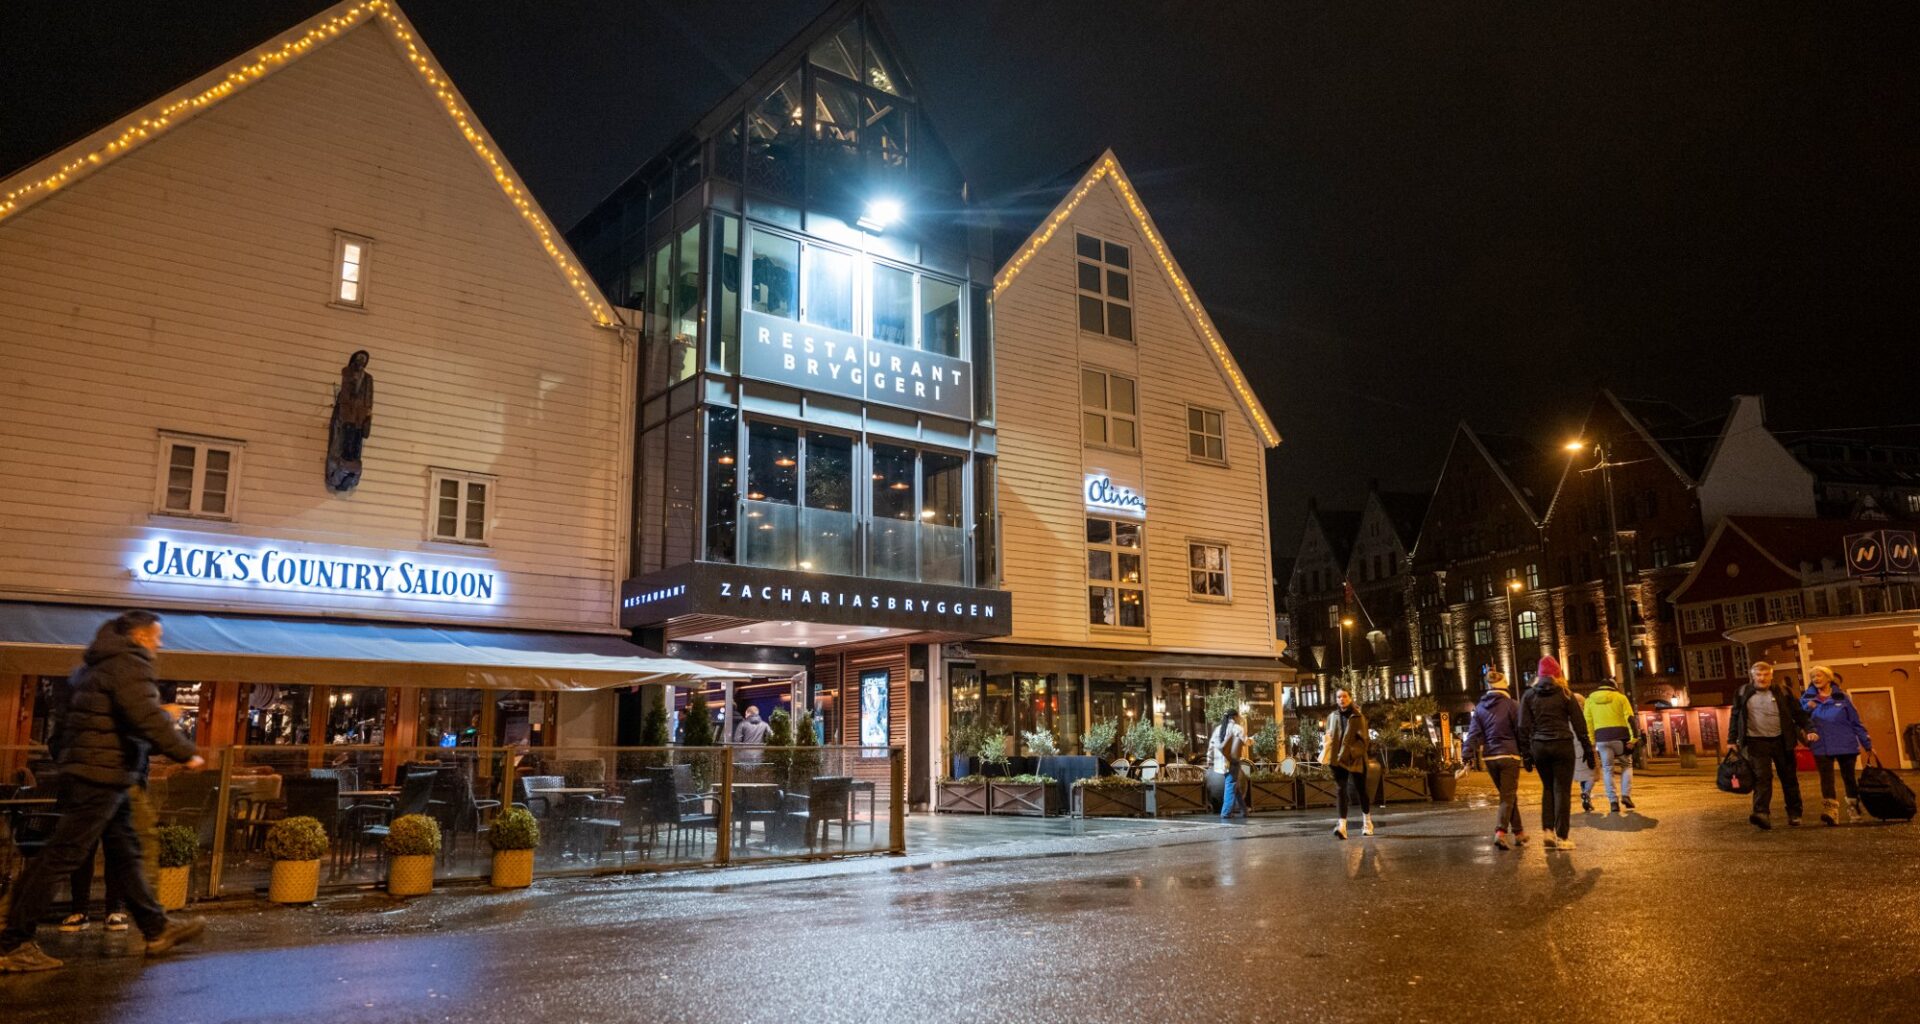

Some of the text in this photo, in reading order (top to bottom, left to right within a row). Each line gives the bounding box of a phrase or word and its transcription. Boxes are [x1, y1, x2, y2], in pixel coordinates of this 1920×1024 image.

[758, 326, 962, 386] RESTAURANT
[783, 353, 940, 400] BRYGGERI
[1088, 477, 1148, 510] Olivia
[261, 549, 392, 592] COUNTRY
[398, 562, 494, 599] SALOON
[624, 584, 686, 608] RESTAURANT
[721, 583, 994, 618] ZACHARIASBRYGGEN
